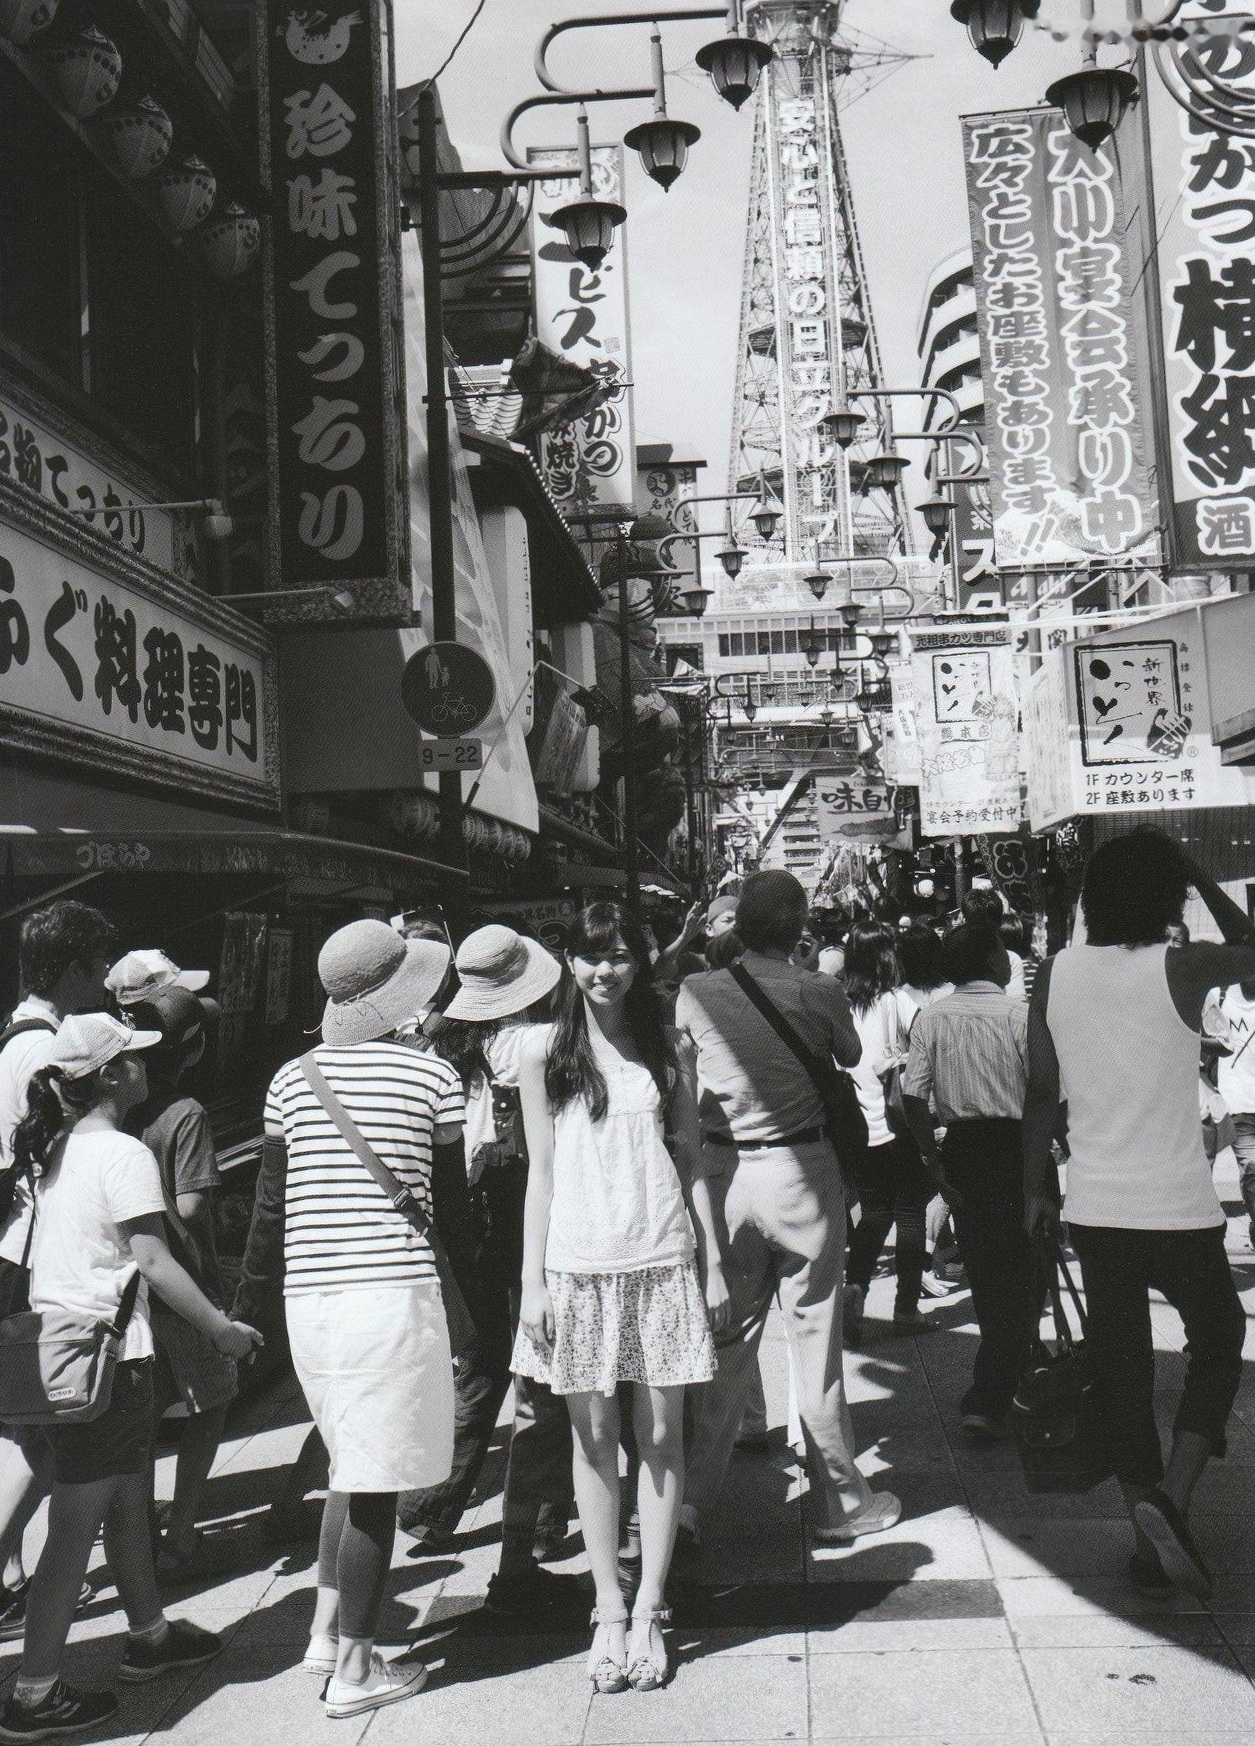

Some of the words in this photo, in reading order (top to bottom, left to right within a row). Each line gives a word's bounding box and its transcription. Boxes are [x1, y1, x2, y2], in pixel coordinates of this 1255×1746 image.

[915, 630, 1007, 648] 元祖串カツ専門店
[1086, 774, 1100, 786] 1F
[1105, 768, 1195, 786] カウンター席
[1086, 792, 1101, 805] 2F
[1105, 787, 1196, 805] 座敷あります
[926, 806, 1017, 824] 宴会予約受付中
